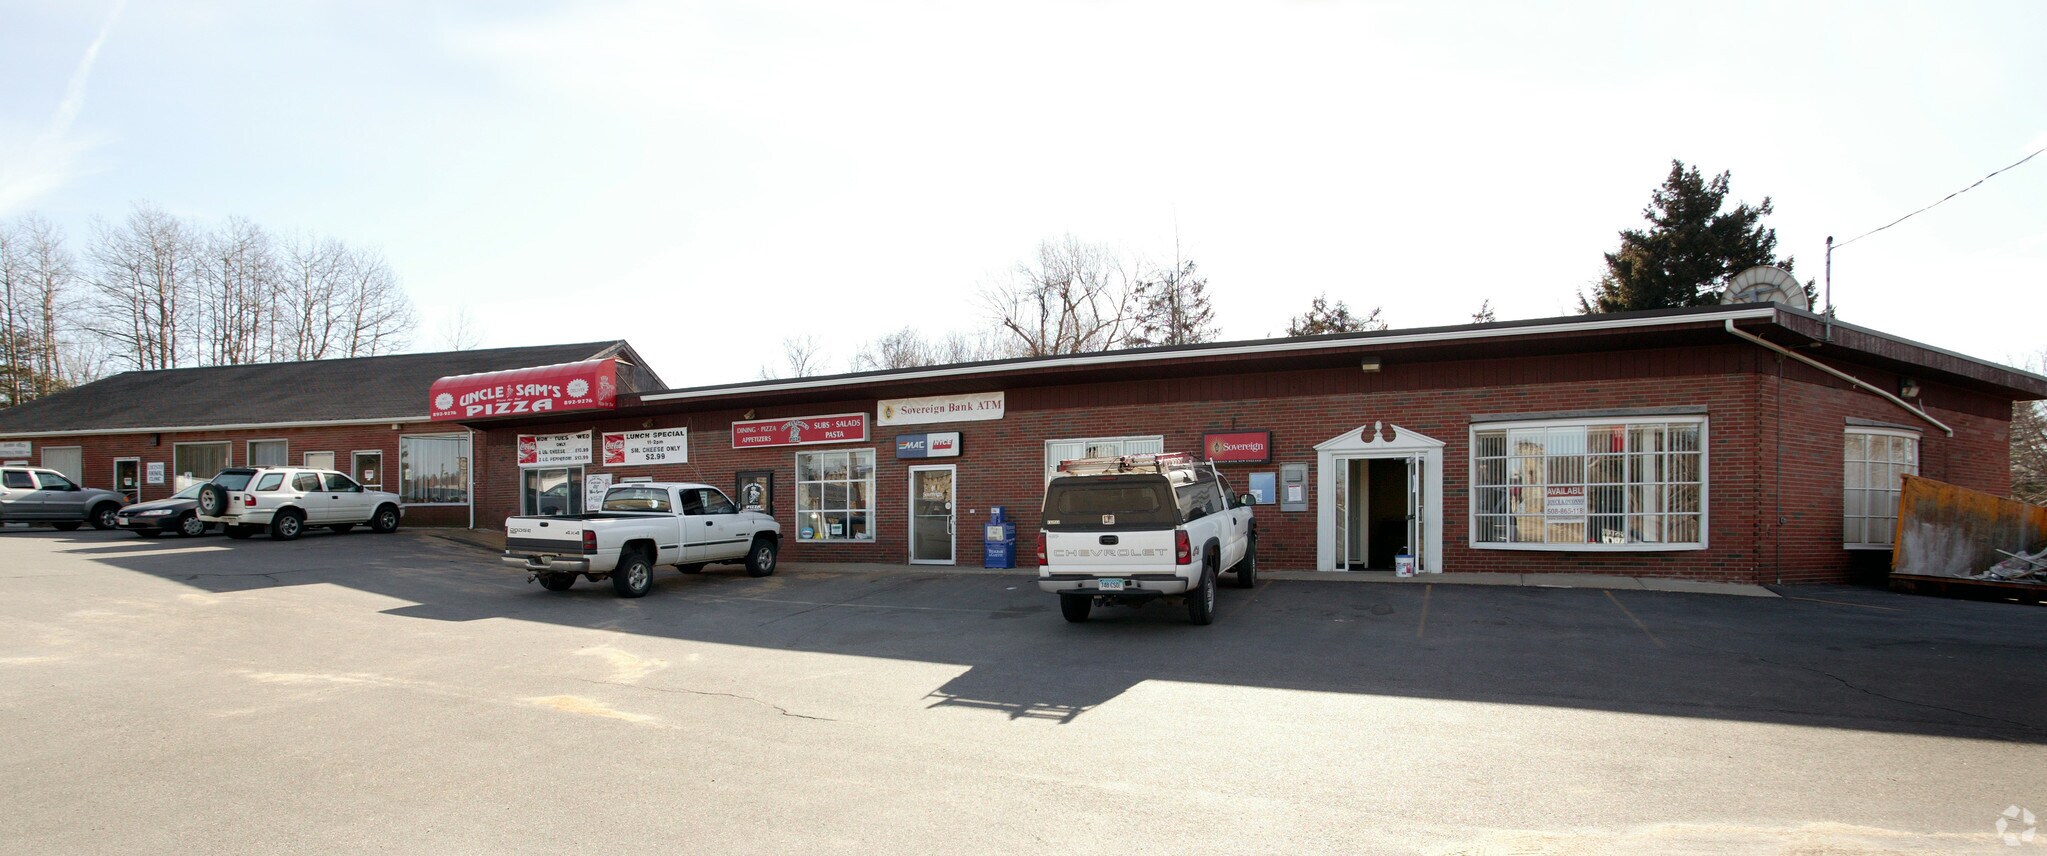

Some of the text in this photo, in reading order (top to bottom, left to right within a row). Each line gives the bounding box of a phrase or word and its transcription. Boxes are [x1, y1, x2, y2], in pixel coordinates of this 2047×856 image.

[459, 382, 562, 407] UNCLE SAM'S
[563, 398, 593, 406] 892-9276
[466, 398, 553, 417] PIZZA
[900, 399, 1002, 416] Sovereign Bank ATM
[813, 418, 862, 429] SUBS SALADS
[736, 425, 777, 434] DINING PIZZA
[626, 430, 685, 440] LUNCH SPECIAL
[741, 435, 772, 444] APPETIZERS
[825, 431, 845, 439] PASTA
[642, 445, 665, 453] CHEESE
[666, 444, 681, 452] ONLY
[907, 441, 925, 449] MAC
[1222, 441, 1265, 453] Sovereign
[645, 452, 666, 461] $2.99
[1053, 548, 1168, 558] CHEVROLET
